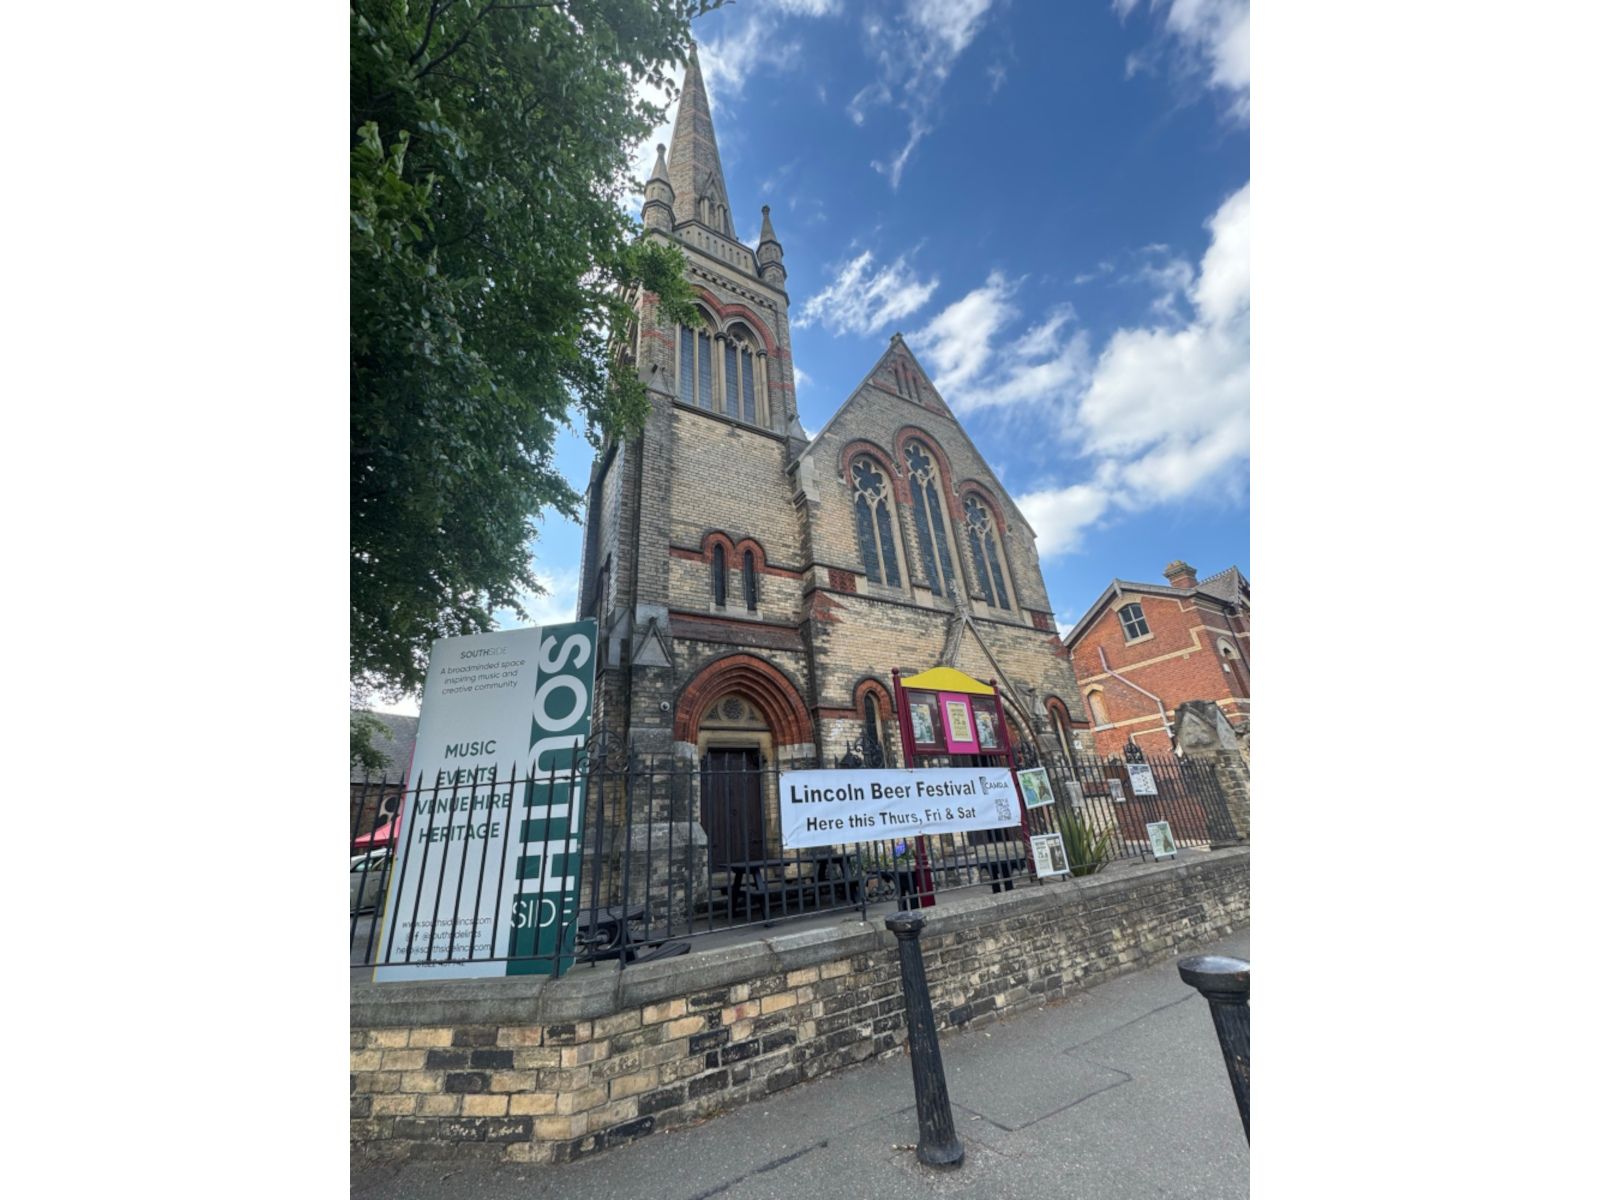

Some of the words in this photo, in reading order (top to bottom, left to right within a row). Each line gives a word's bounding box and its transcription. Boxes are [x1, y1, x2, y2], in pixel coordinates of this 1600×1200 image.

[460, 646, 509, 659] SOUTHSIDE
[440, 667, 446, 675] A
[447, 661, 500, 674] broadminded
[501, 659, 526, 669] space
[444, 674, 477, 685] inspiring
[478, 671, 500, 680] music
[502, 669, 518, 677] and
[442, 685, 473, 695] creative
[474, 680, 518, 691] community
[445, 740, 497, 759] MUSIC
[437, 766, 497, 785] EVENTS
[790, 783, 865, 803] Lincoln
[871, 782, 911, 799] Beer
[916, 780, 976, 797] Festival
[417, 796, 470, 815] VENUE
[473, 793, 512, 810] HIRE
[807, 816, 844, 832] Here
[849, 813, 875, 828] this
[879, 812, 922, 824] Thurs,
[925, 808, 942, 821] Fri
[945, 807, 954, 820] &
[957, 806, 976, 819] Sat
[418, 822, 500, 844] HERITAGE
[510, 897, 573, 928] SIDE
[402, 917, 492, 928] www.sohsidincsom
[422, 930, 482, 941] @outhdelins
